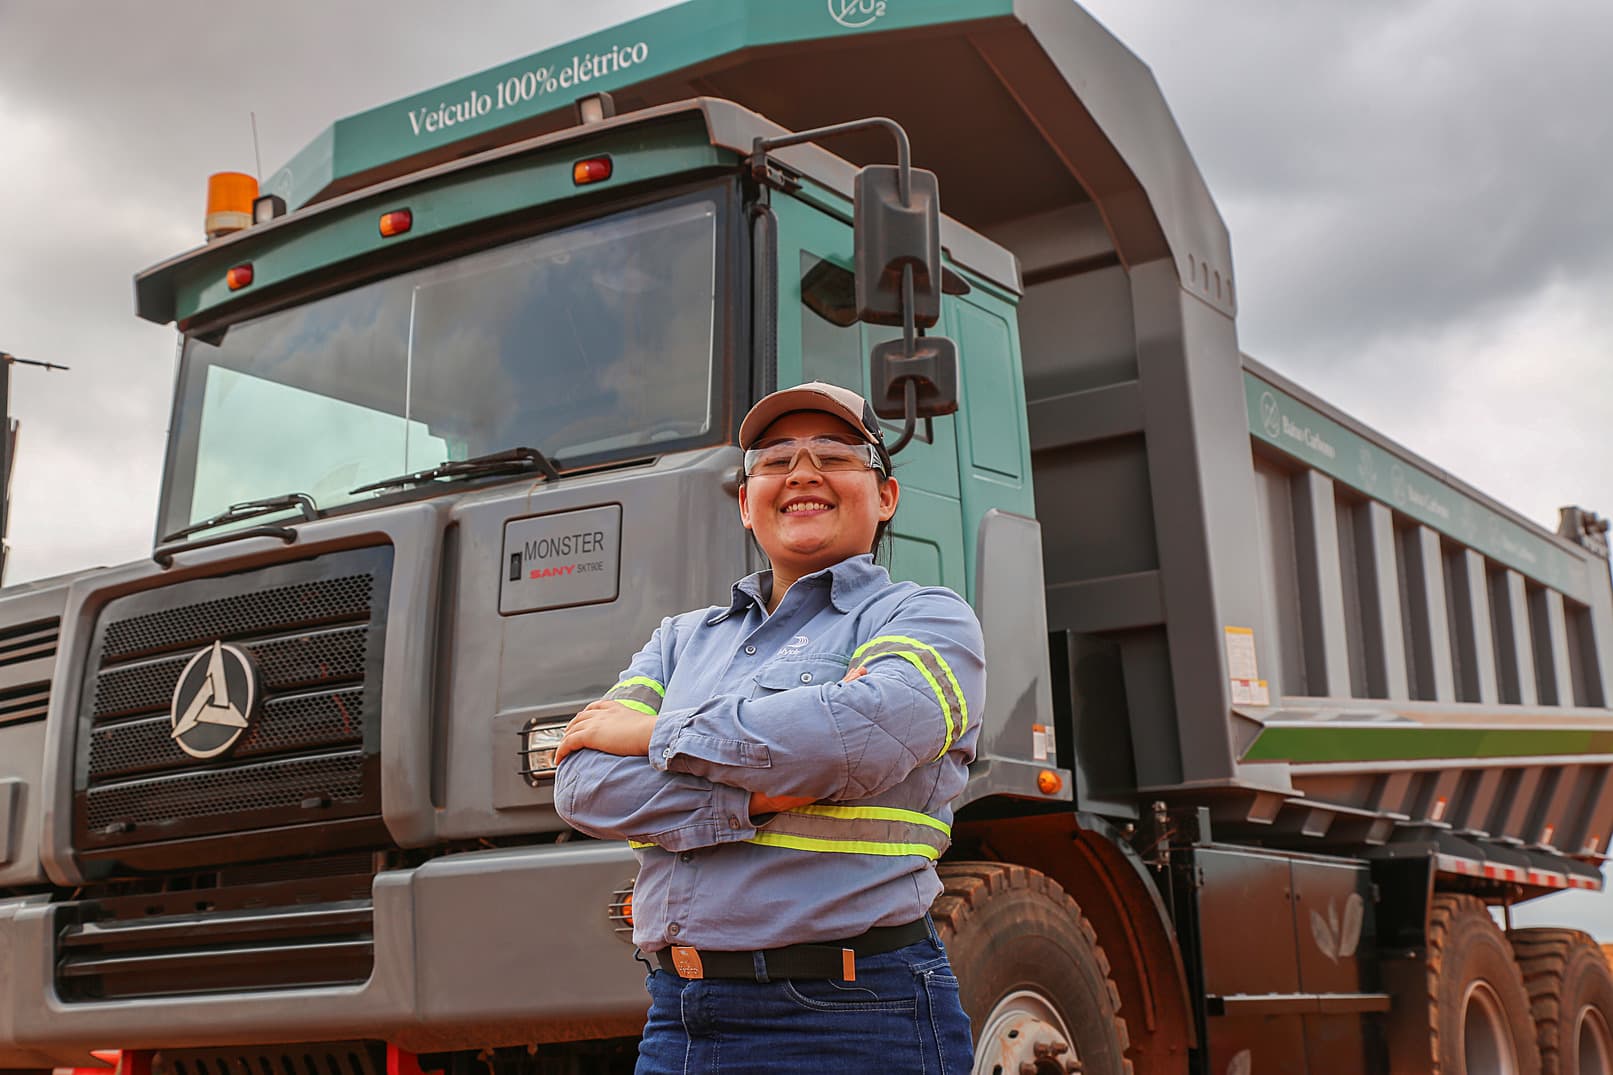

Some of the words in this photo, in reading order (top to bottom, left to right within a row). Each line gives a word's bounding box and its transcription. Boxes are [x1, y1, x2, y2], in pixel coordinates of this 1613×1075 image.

[407, 85, 492, 137] Veículo
[496, 67, 557, 109] 100%
[558, 41, 649, 90] elétrico
[524, 531, 604, 561] MONSTER
[529, 564, 576, 580] SANY
